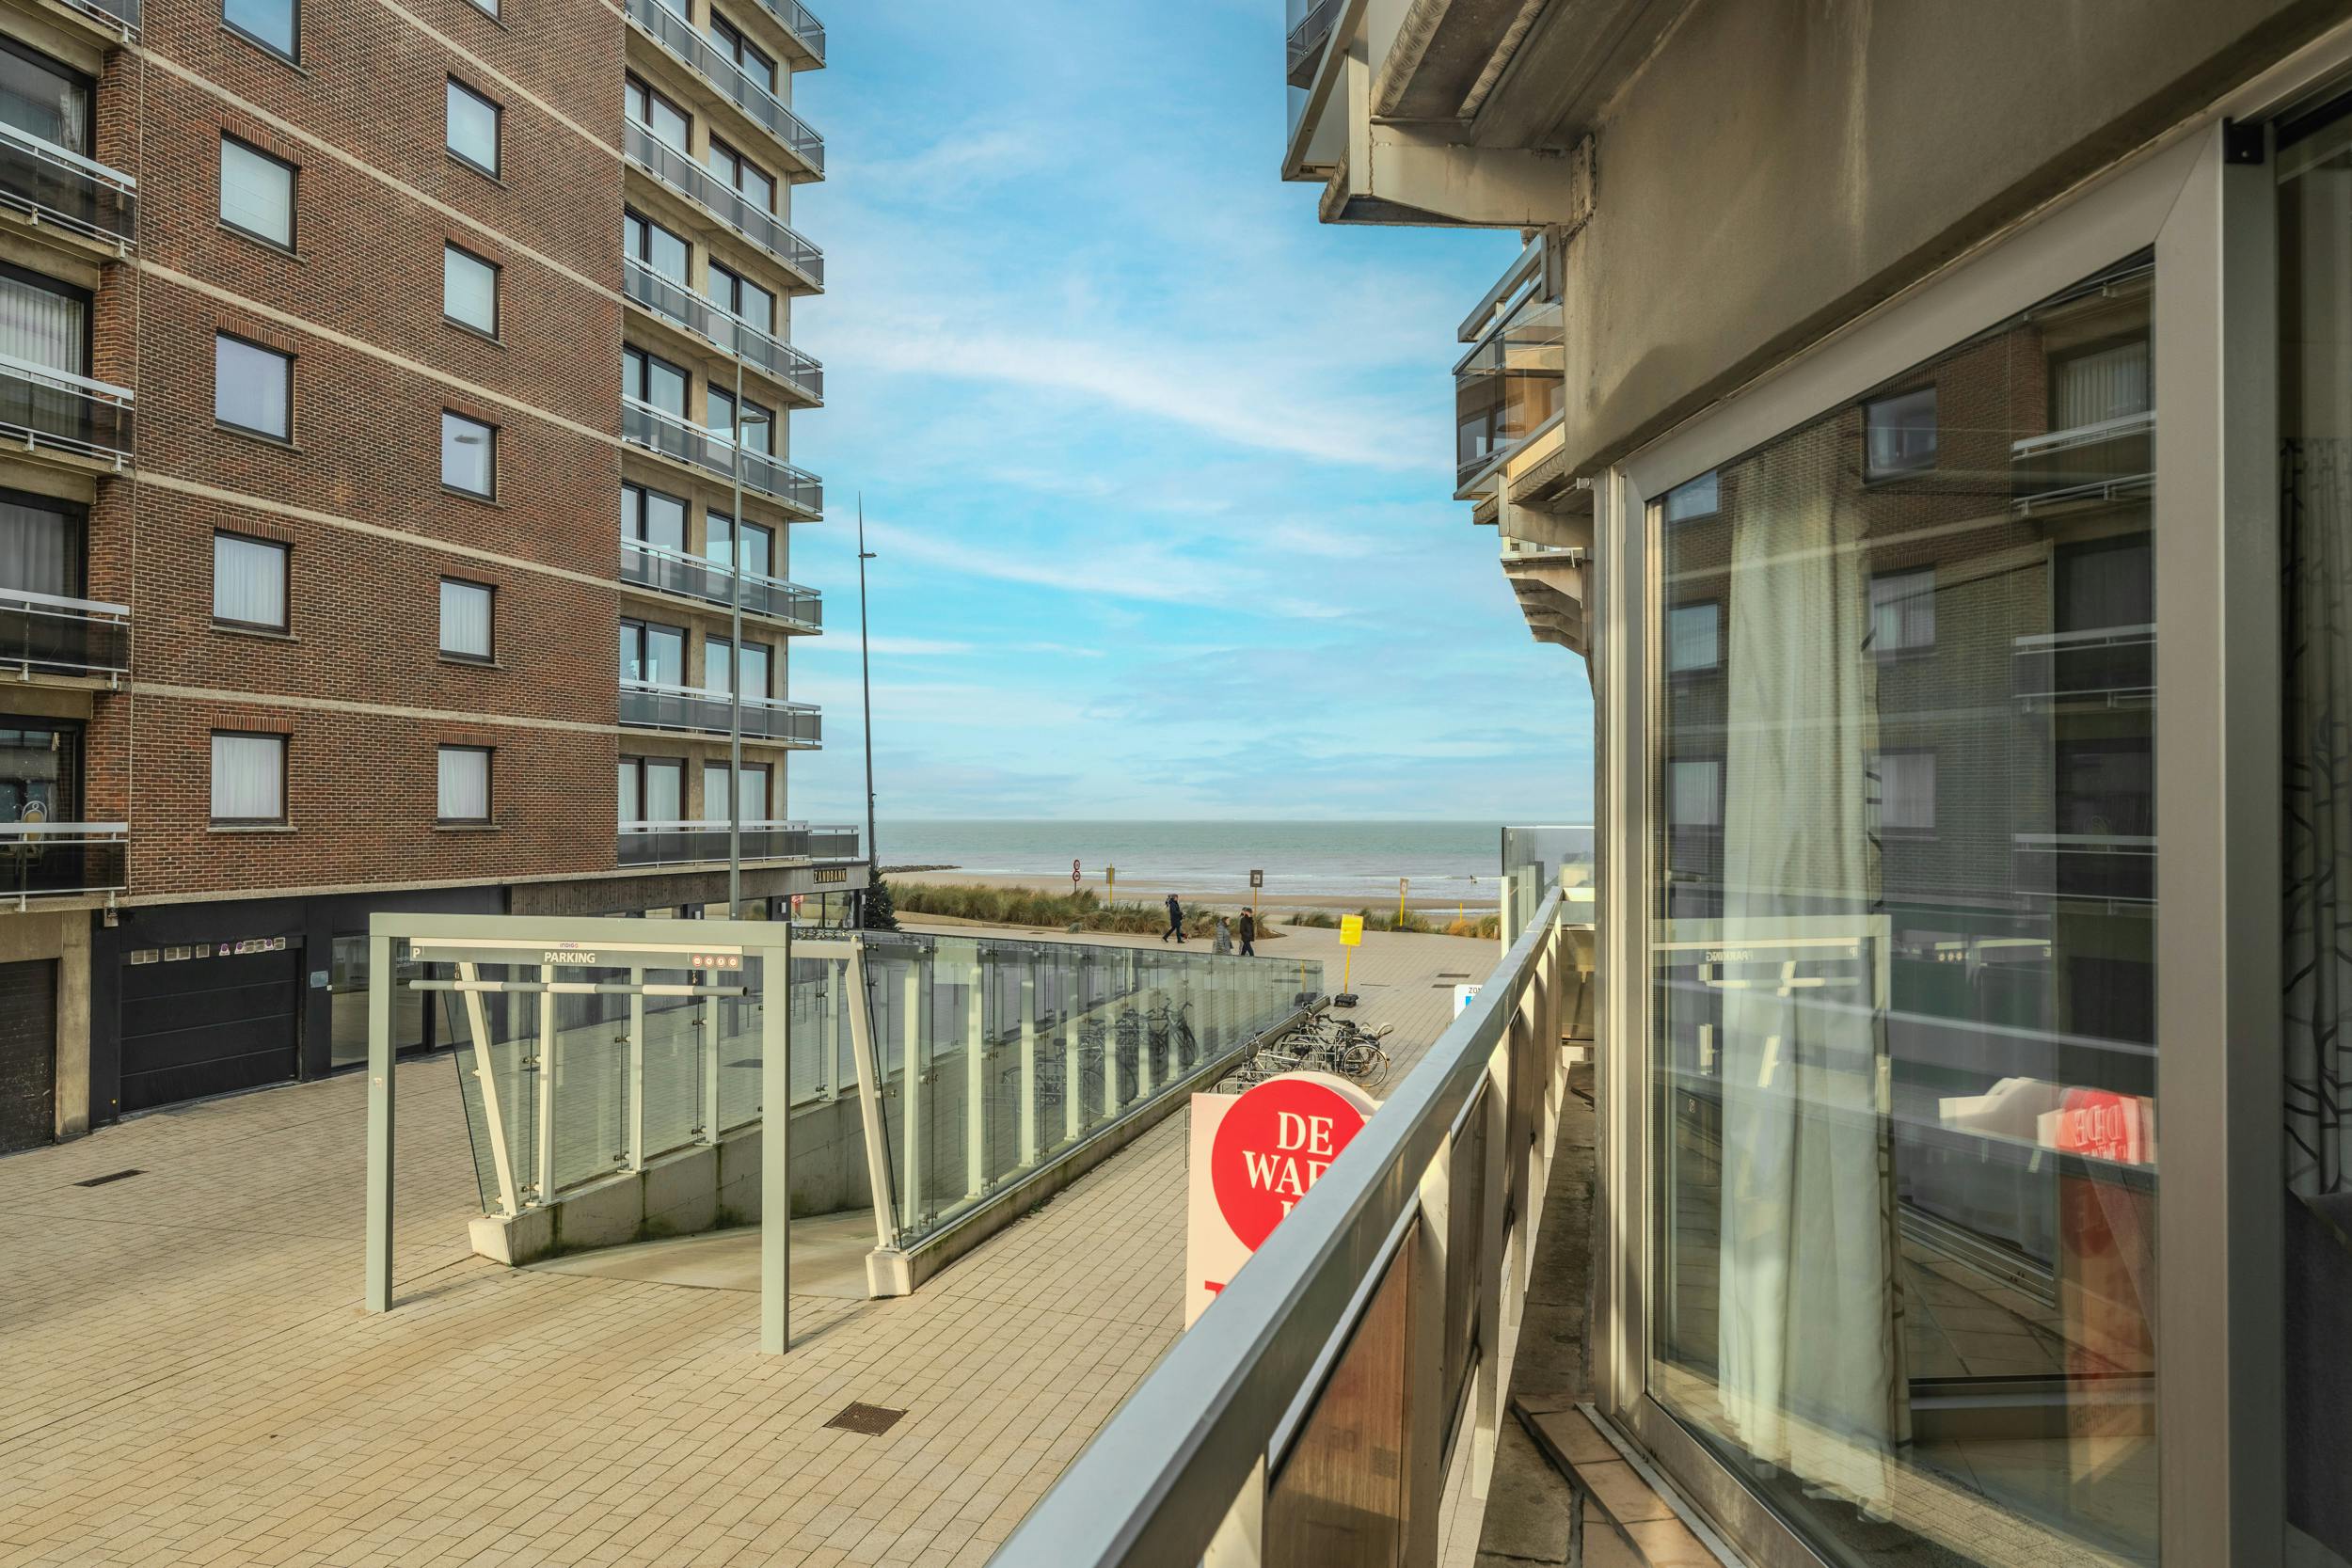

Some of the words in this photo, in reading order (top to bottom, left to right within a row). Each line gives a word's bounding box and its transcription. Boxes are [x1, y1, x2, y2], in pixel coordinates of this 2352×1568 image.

[814, 870, 846, 882] ZANDBANK
[412, 947, 421, 958] P
[544, 951, 596, 963] PARKING
[1277, 1111, 1334, 1156] DE
